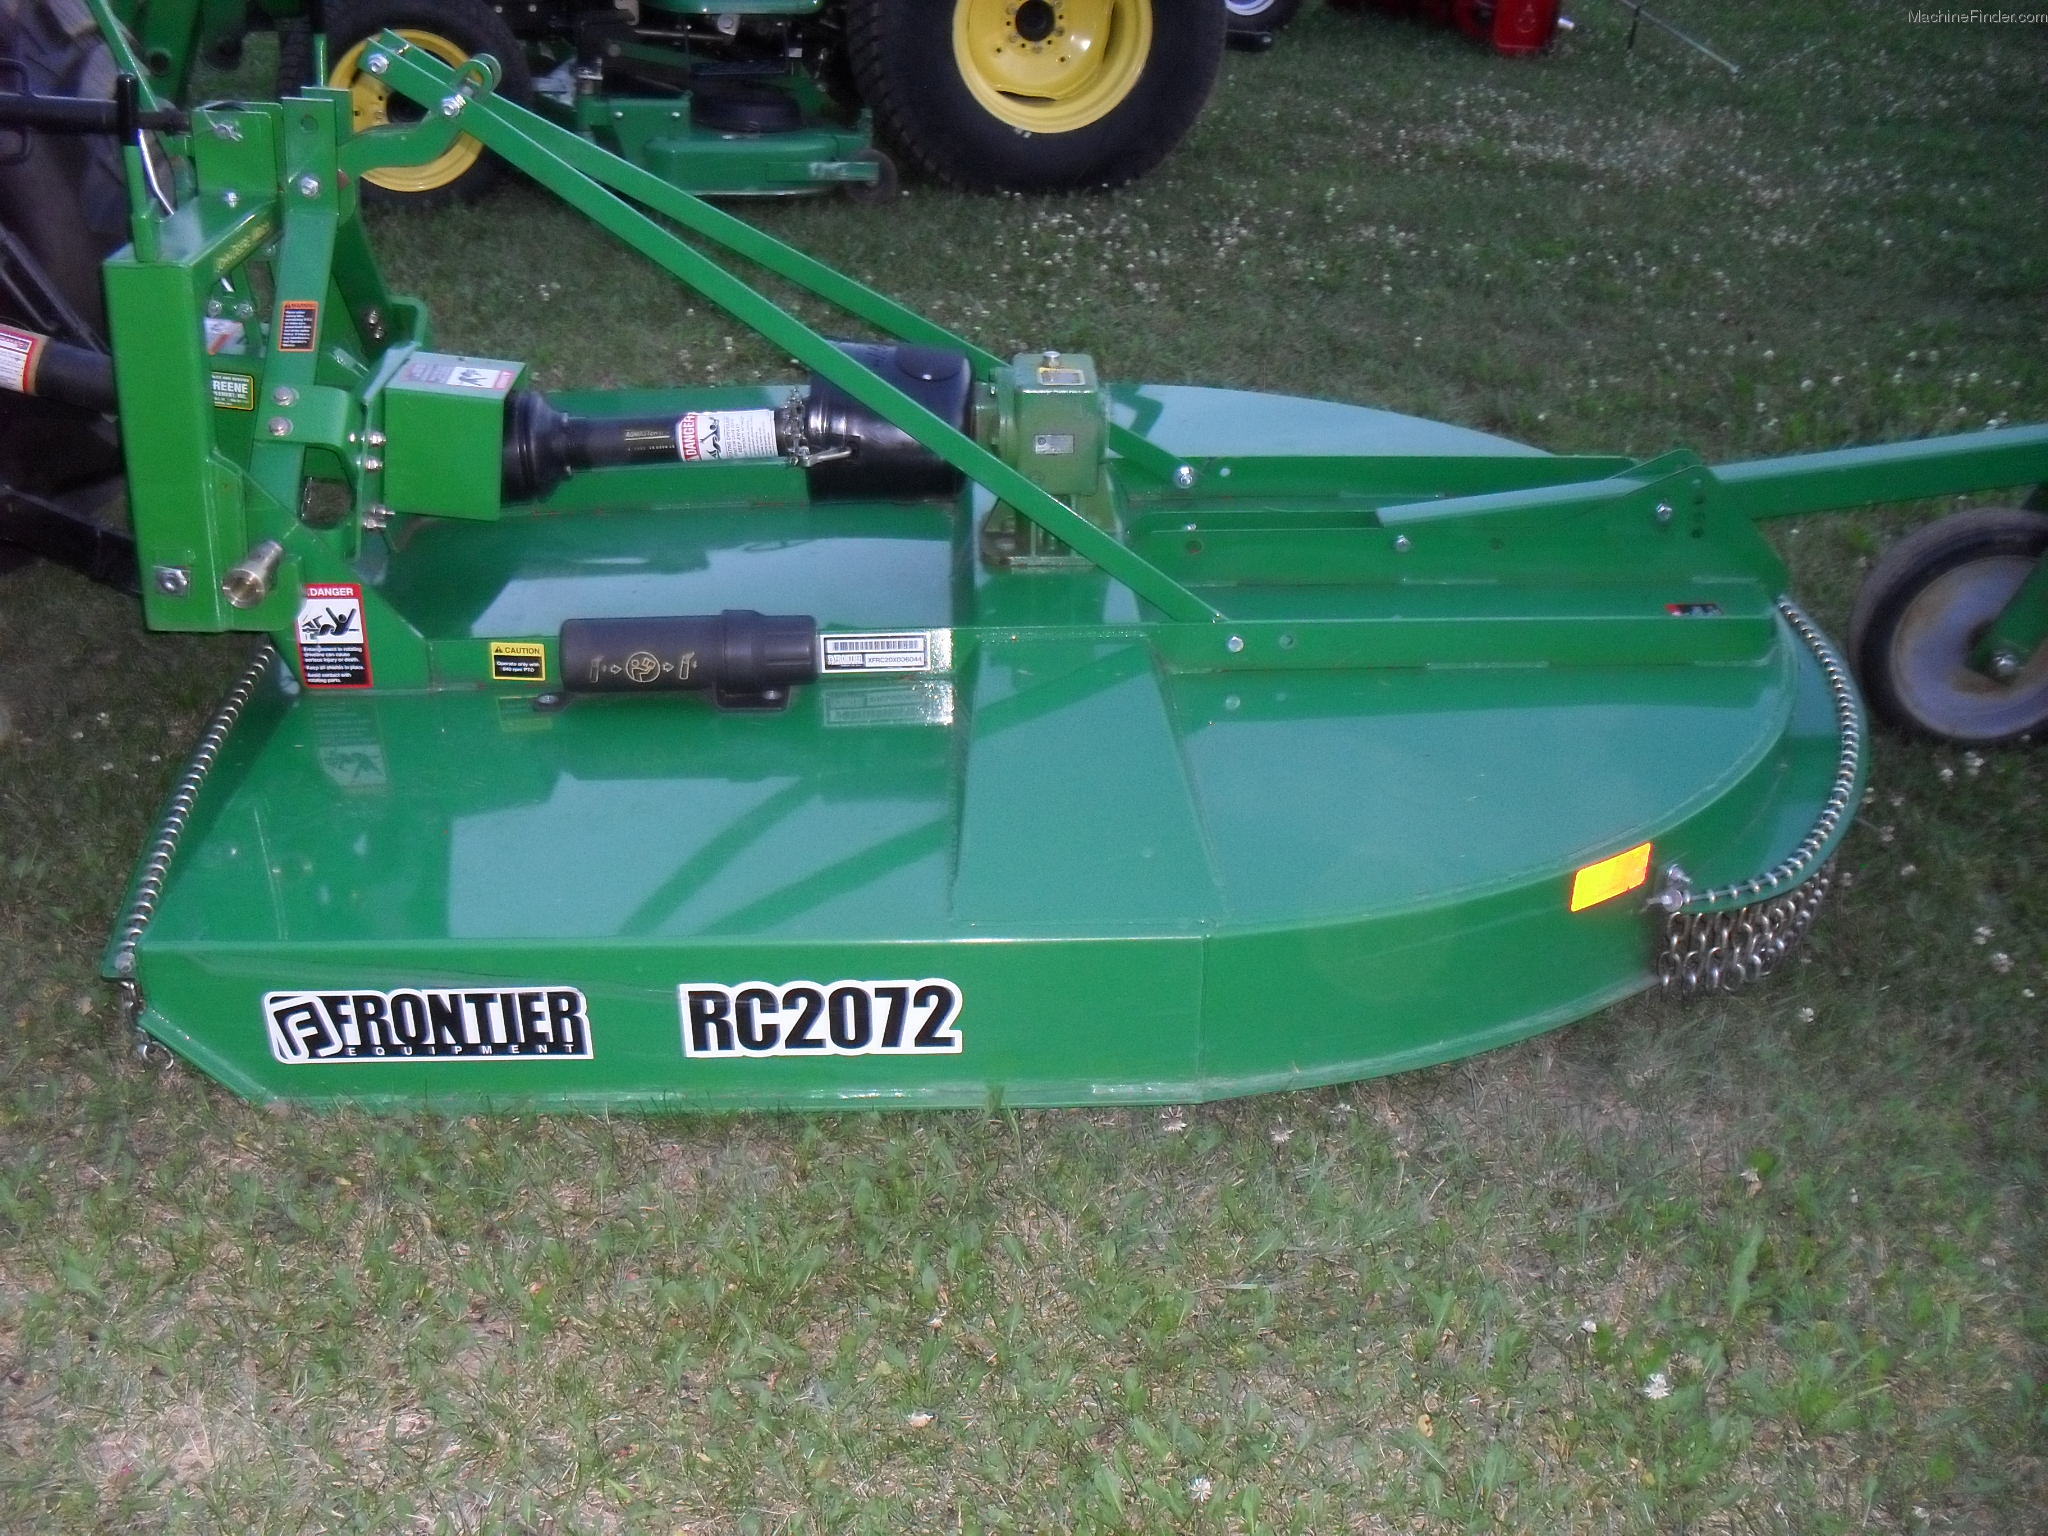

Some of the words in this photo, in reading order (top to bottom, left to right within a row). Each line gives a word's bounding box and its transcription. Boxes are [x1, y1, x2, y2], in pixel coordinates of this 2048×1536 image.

[681, 412, 697, 456] DANGER
[309, 587, 354, 596] DANGER
[320, 990, 589, 1046] FRONTIER
[688, 985, 956, 1052] RC2072
[348, 1043, 575, 1056] EQUIPMENT
